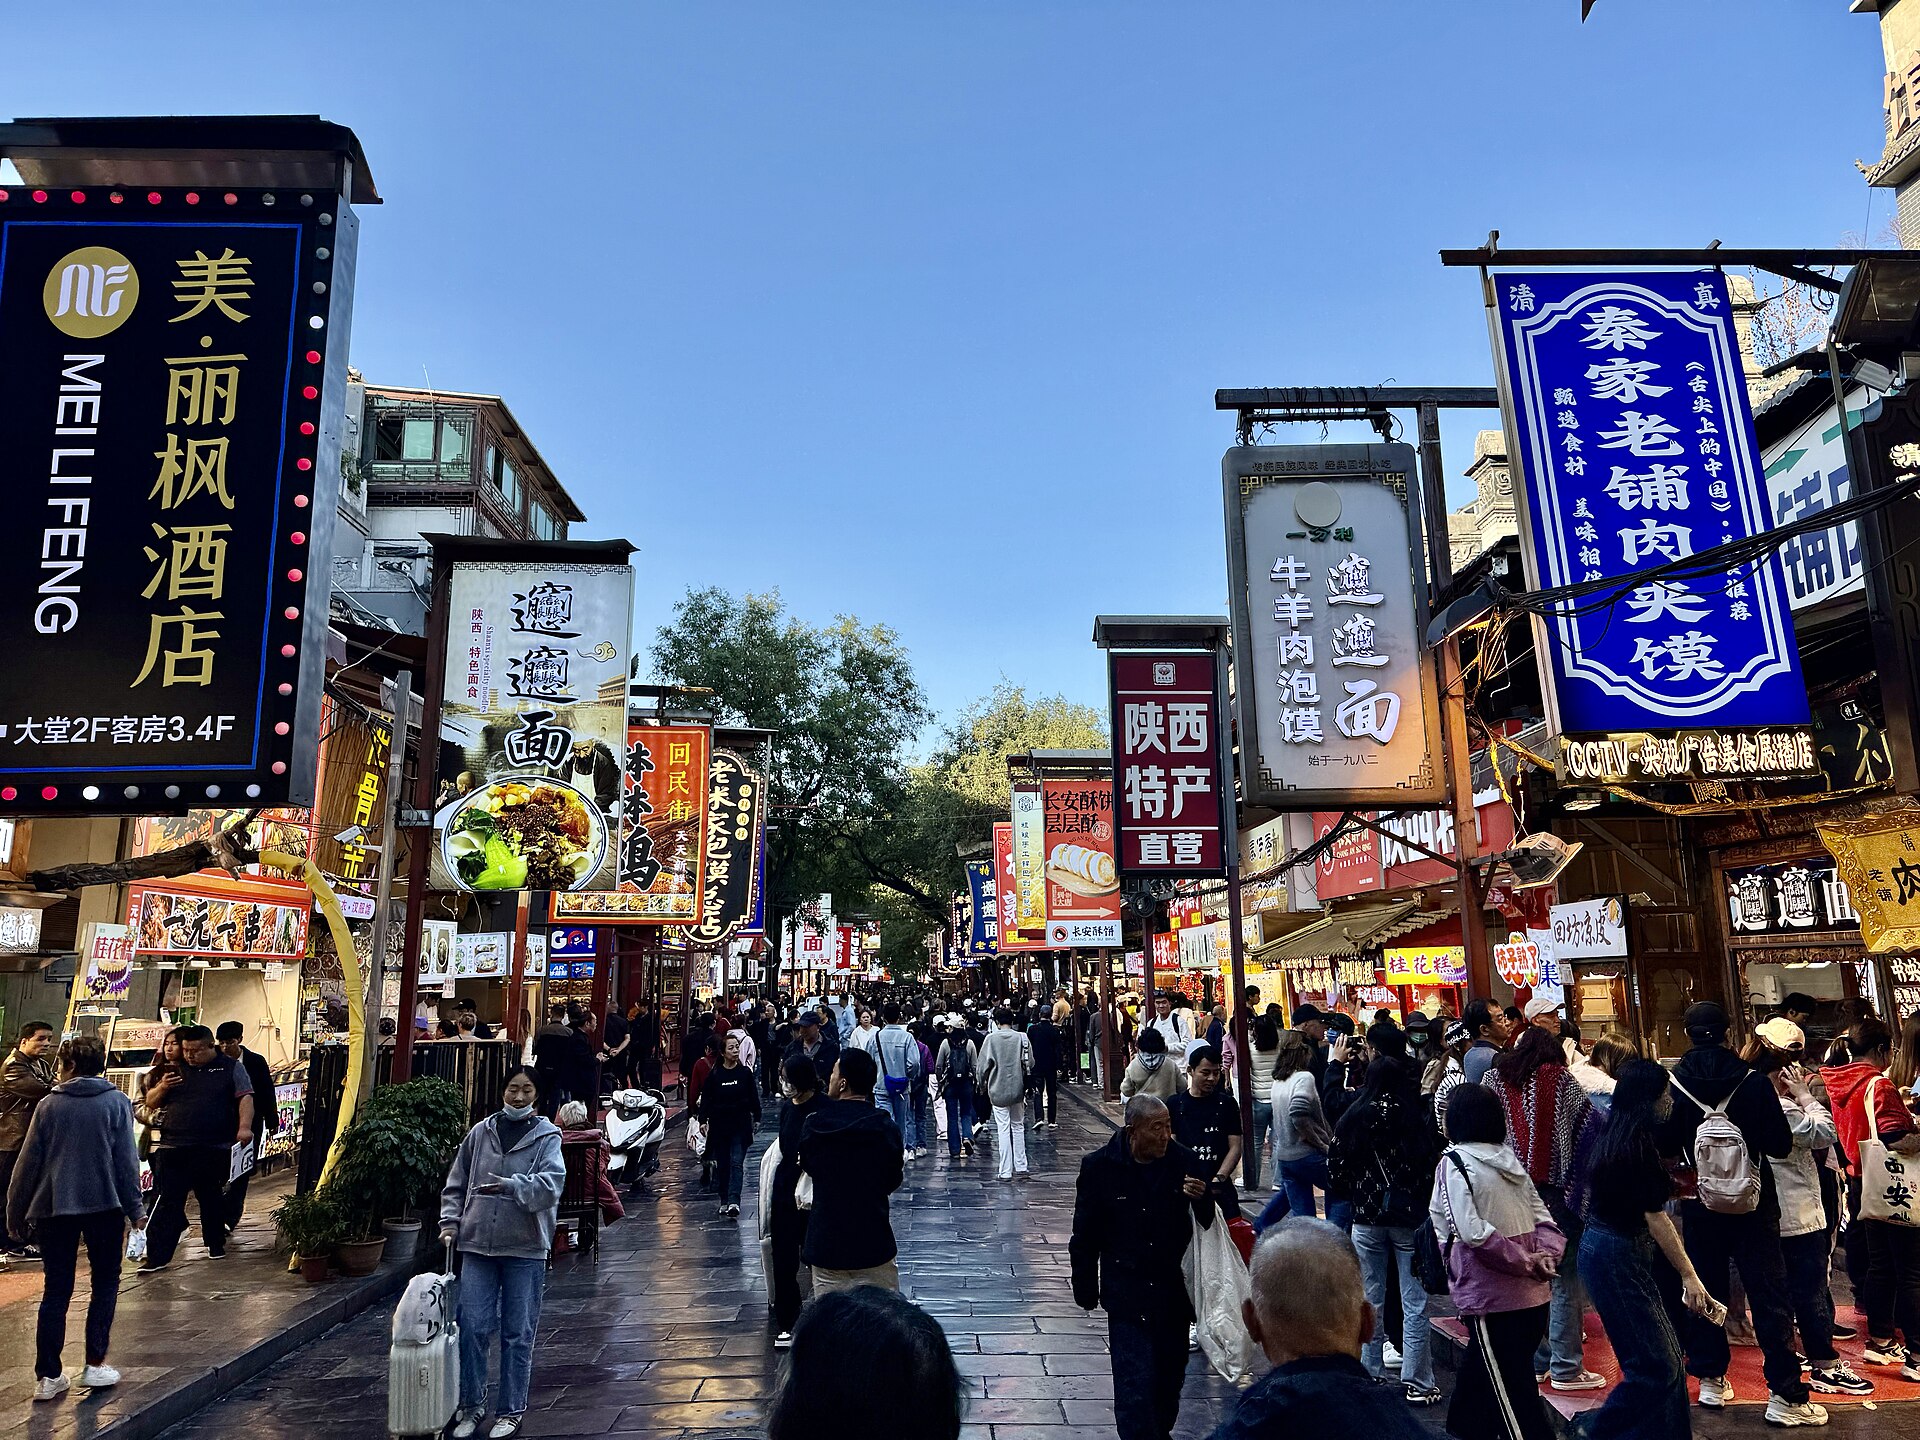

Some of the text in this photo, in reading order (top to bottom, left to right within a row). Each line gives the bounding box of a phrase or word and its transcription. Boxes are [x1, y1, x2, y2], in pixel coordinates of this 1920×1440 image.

[1578, 306, 1728, 681] 秦家老铺肉夹馍
[1285, 526, 1355, 542] 一分利
[1269, 555, 1325, 745] 牛羊肉泡馍
[1124, 701, 1208, 755] 陕西
[1308, 754, 1379, 766] 始于一九八二
[663, 742, 693, 822] 回民街
[1125, 765, 1211, 819] 特产
[1045, 789, 1113, 812] 长安酥饼
[1138, 832, 1203, 865] 直营
[163, 900, 261, 954] 一元一串
[1072, 925, 1115, 937] 长安酥饼
[1553, 909, 1611, 948] 回坊凉皮
[1389, 954, 1454, 974] 桂花糕
[1496, 945, 1538, 971] 柿子熟了
